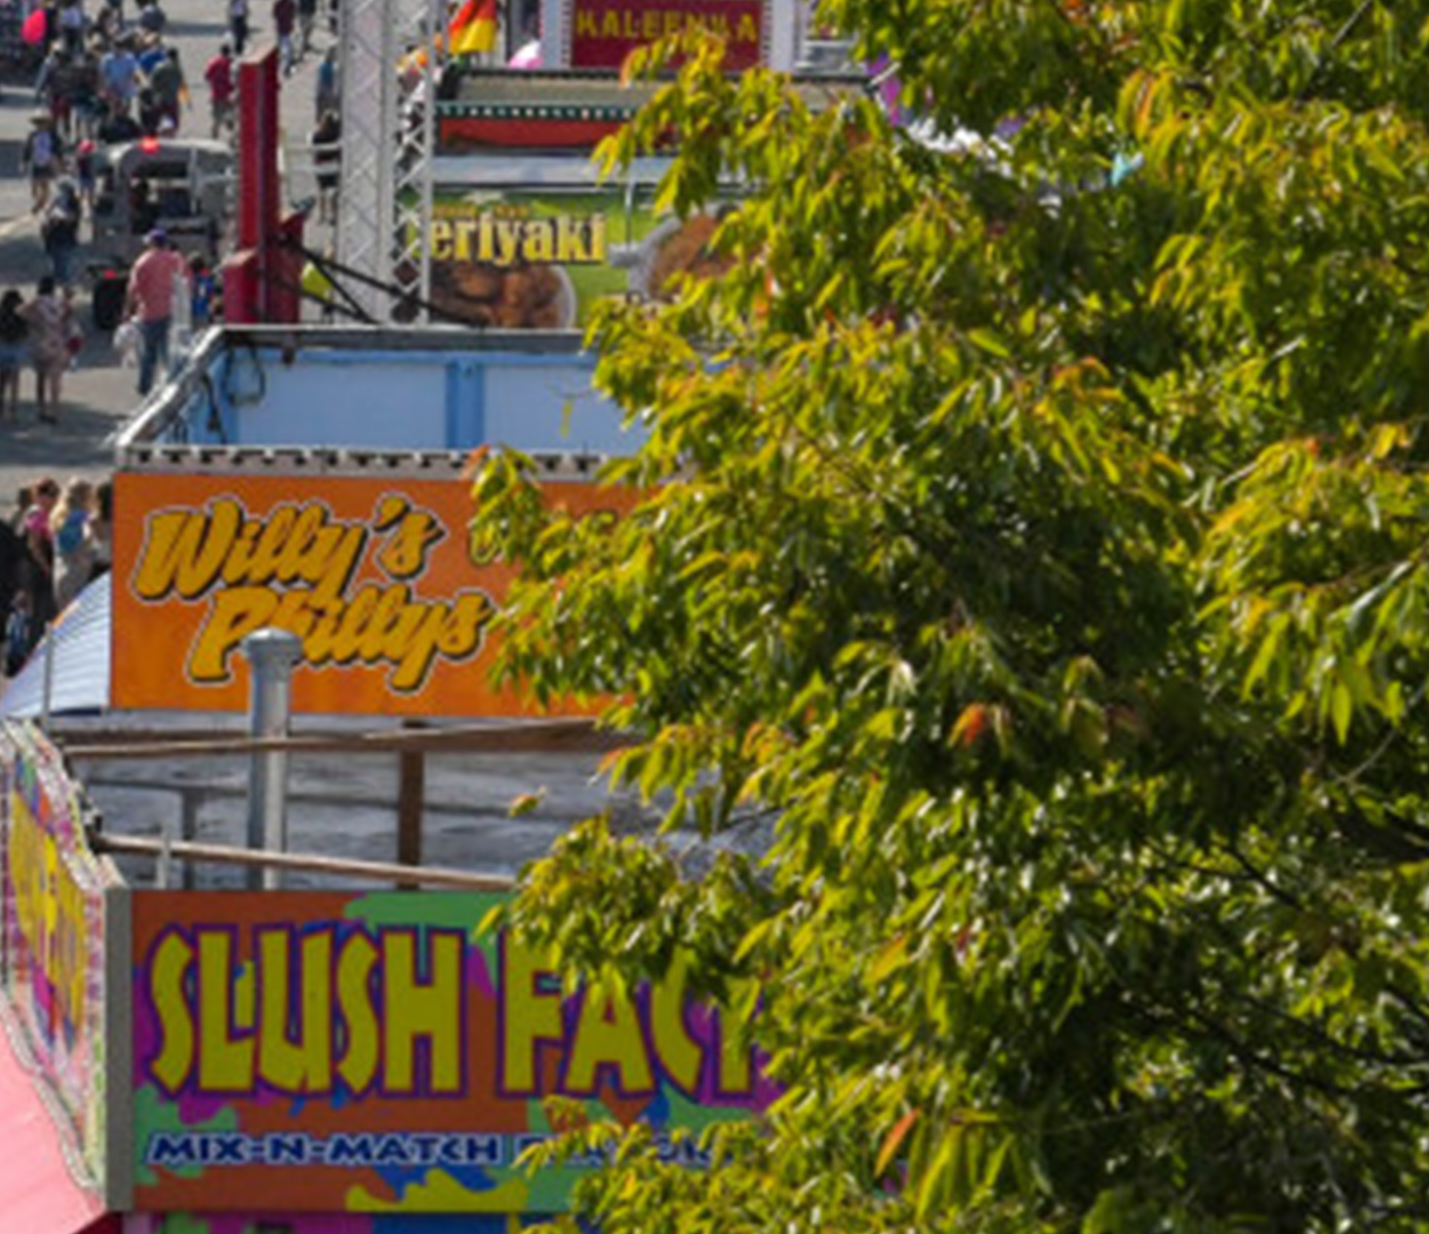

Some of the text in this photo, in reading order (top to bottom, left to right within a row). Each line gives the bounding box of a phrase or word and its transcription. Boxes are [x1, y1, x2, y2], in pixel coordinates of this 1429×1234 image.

[429, 211, 607, 268] eriyaki
[133, 493, 445, 606] Willy's
[187, 582, 491, 694] Phillys
[149, 922, 465, 1098] SLUSH
[148, 1134, 500, 1164] MIX-N-MATCH
